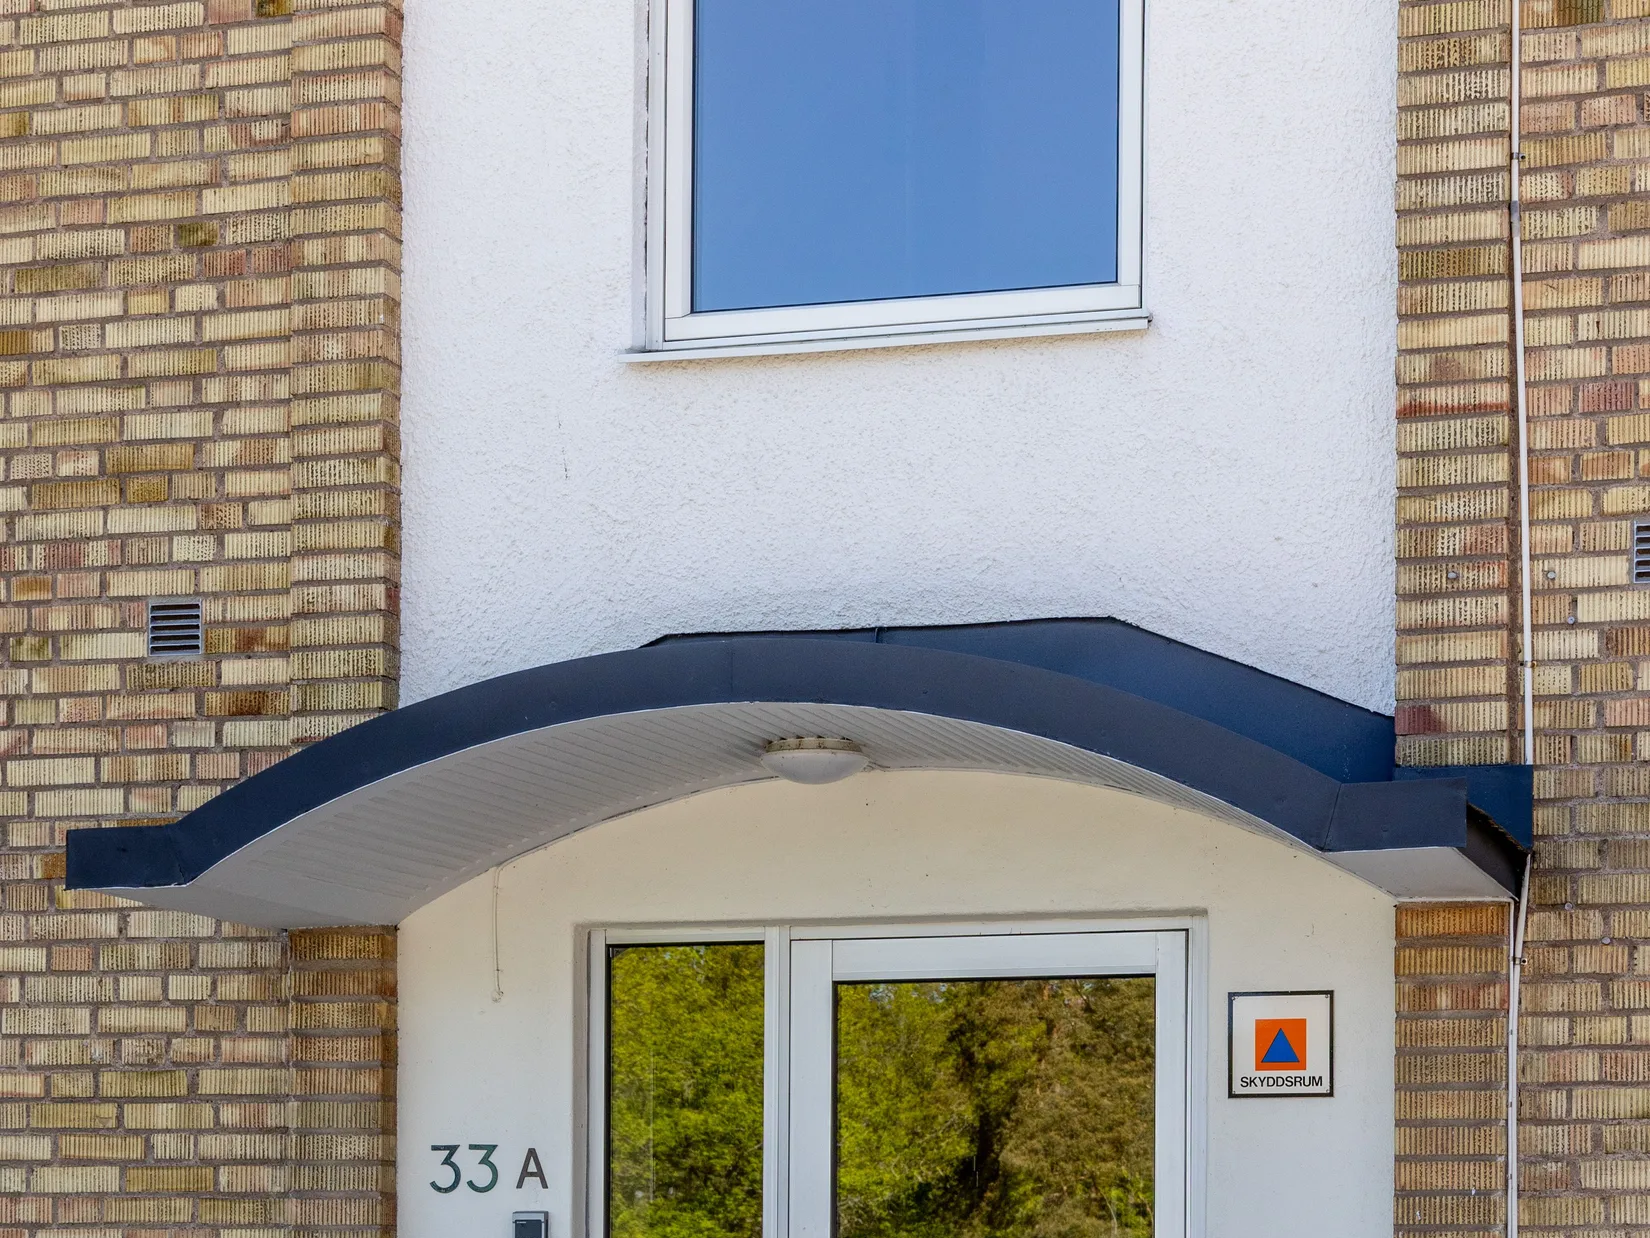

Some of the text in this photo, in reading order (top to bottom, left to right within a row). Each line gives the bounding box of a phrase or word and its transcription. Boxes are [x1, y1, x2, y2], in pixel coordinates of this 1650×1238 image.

[1240, 1076, 1323, 1088] SKYDDSRUM
[429, 1144, 549, 1194] 33 A
